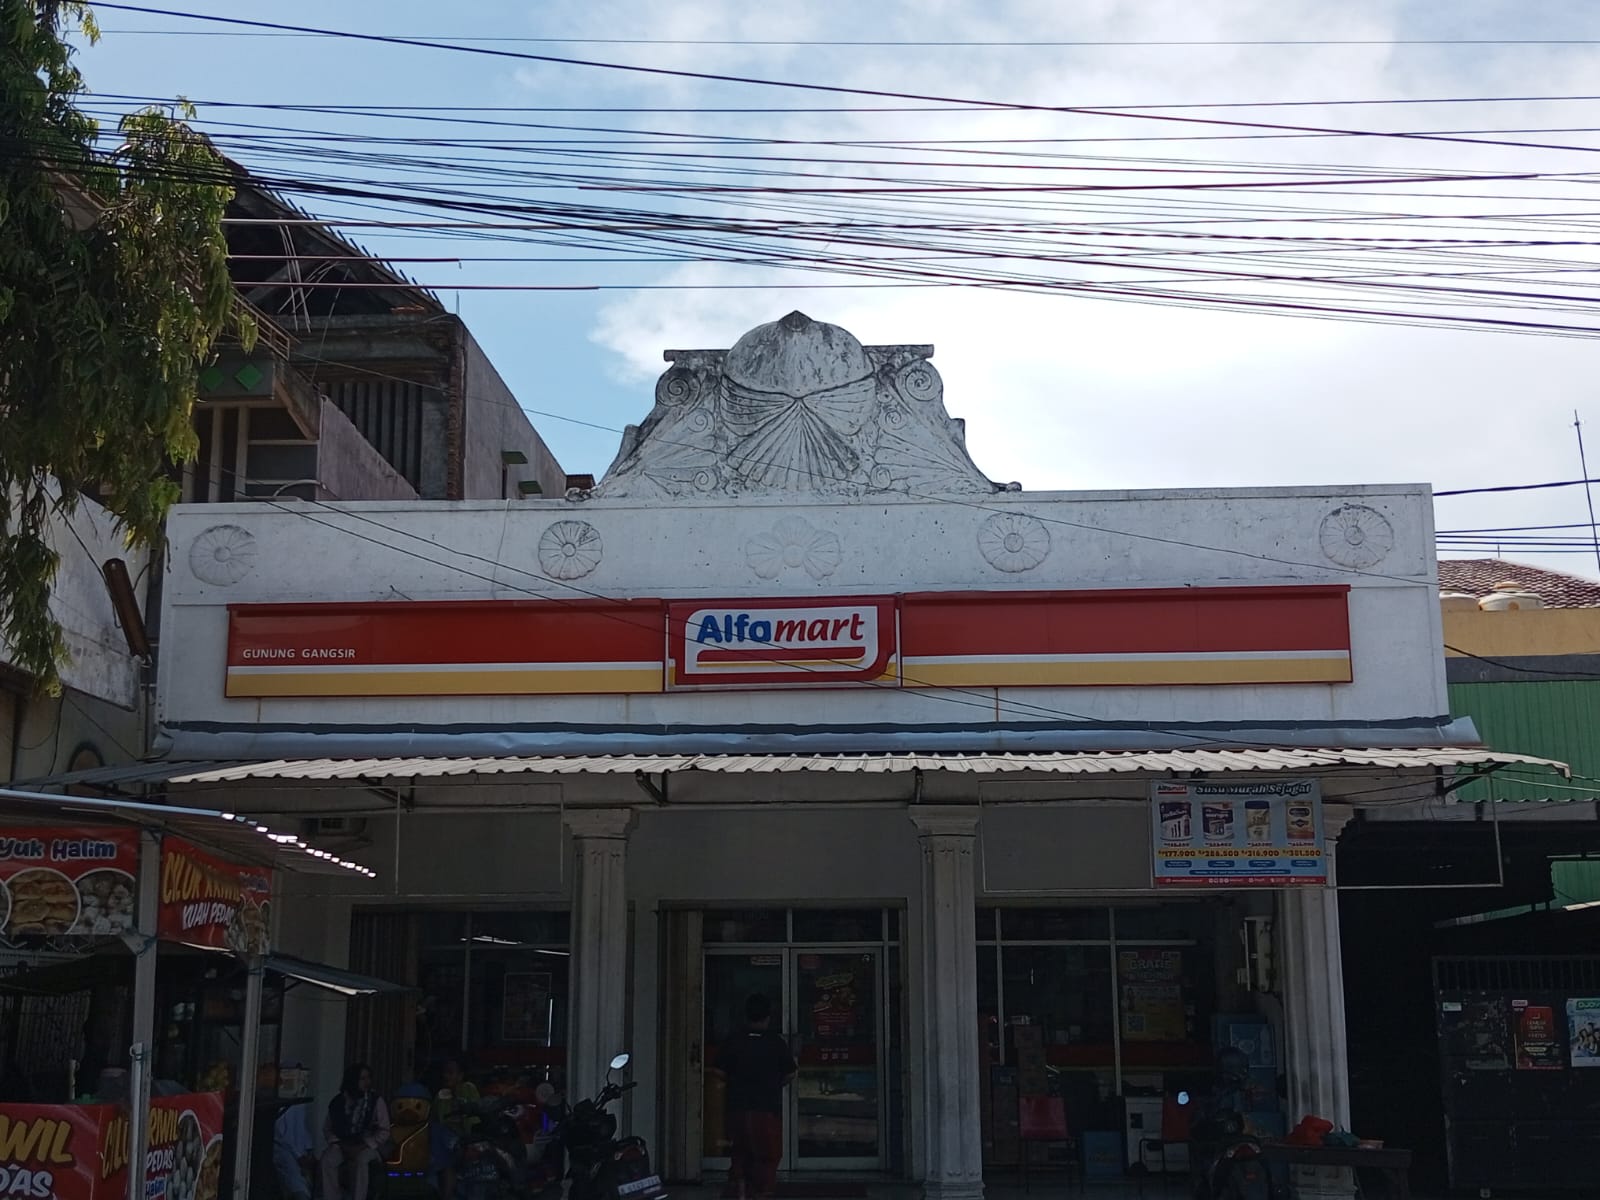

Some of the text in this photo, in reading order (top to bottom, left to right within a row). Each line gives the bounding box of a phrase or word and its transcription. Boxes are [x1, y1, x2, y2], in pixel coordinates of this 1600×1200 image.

[697, 613, 865, 644] Alfamart
[242, 648, 356, 659] GUNUNG GANGSIR
[51, 839, 117, 861] Halim
[148, 1107, 179, 1147] RIWIL
